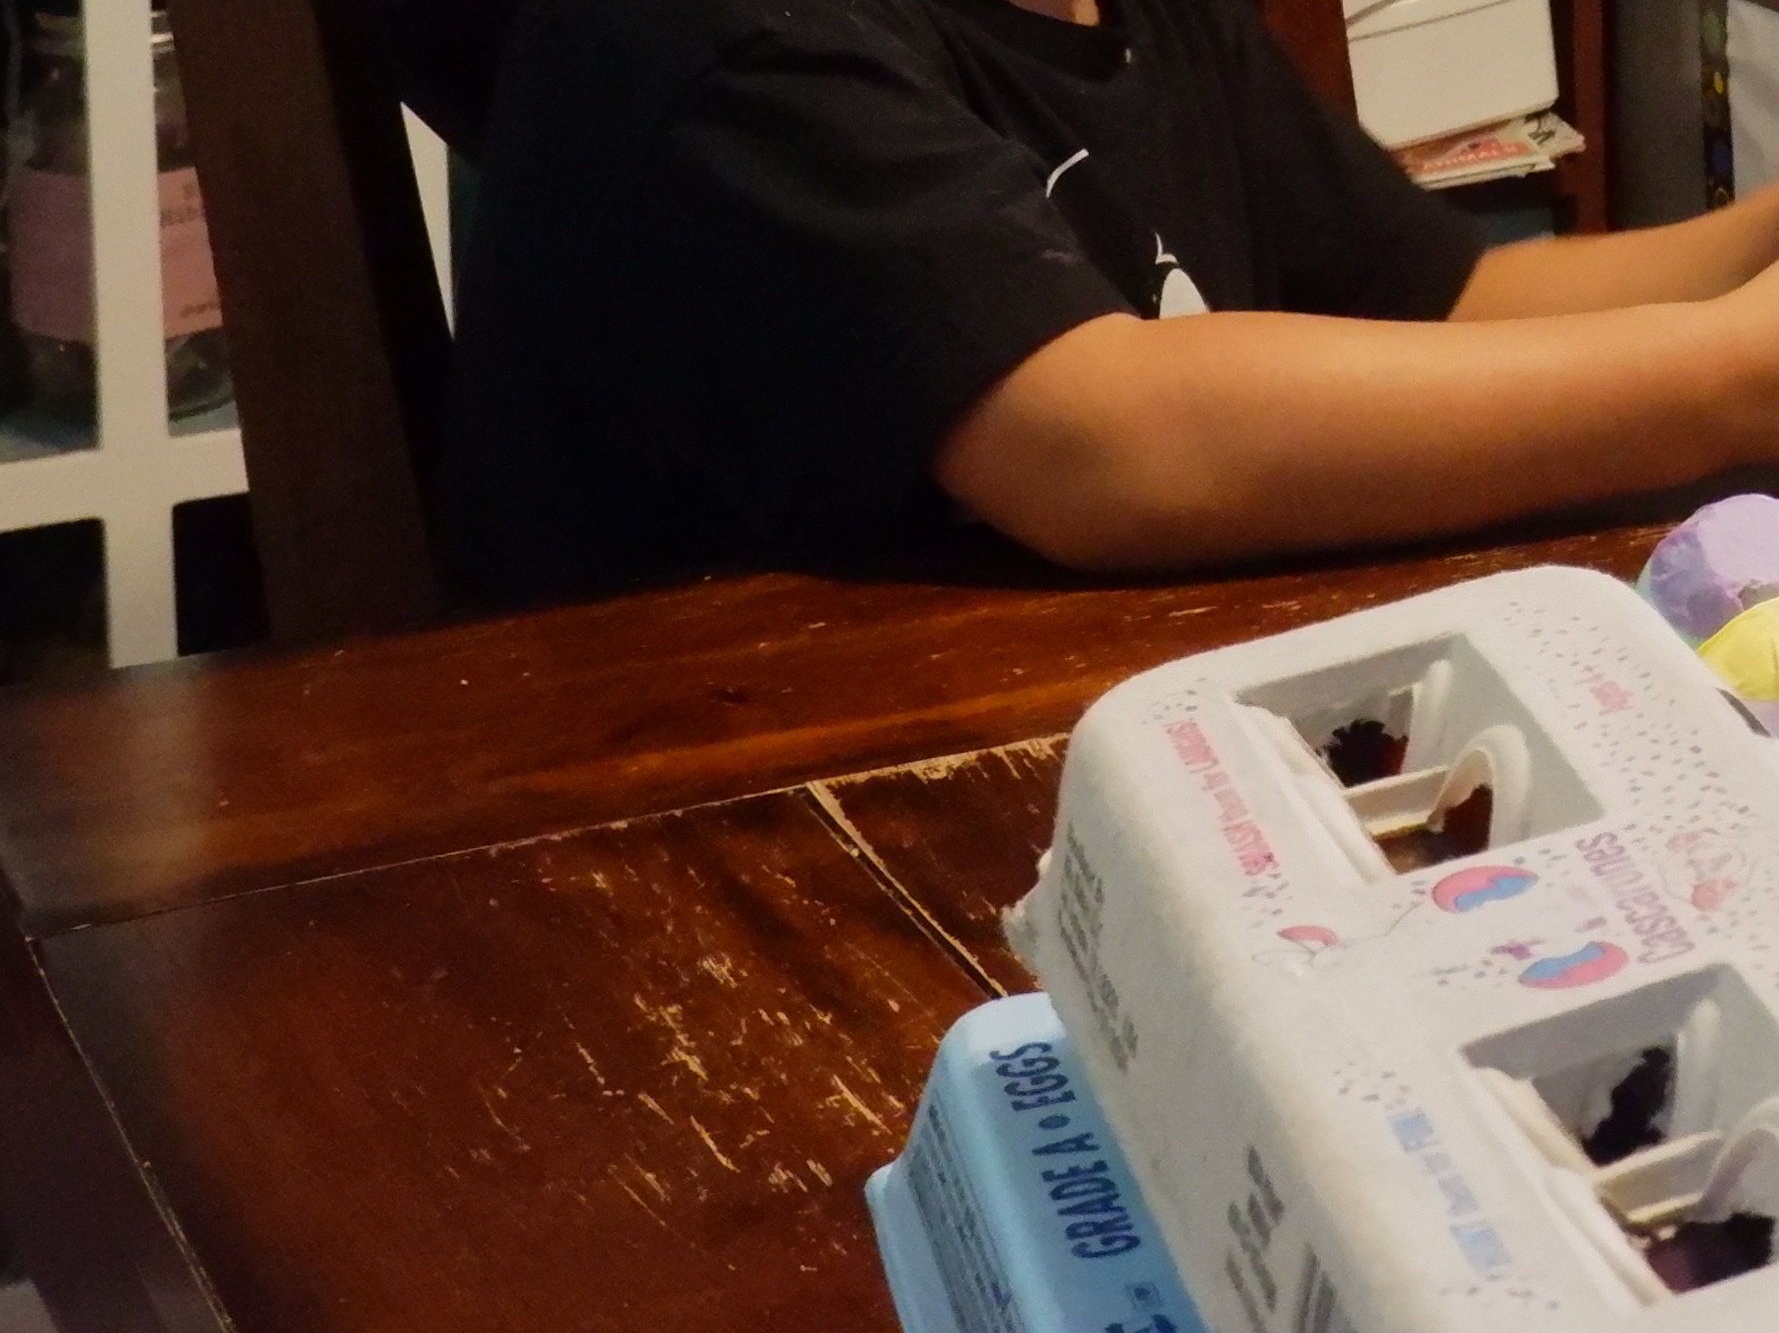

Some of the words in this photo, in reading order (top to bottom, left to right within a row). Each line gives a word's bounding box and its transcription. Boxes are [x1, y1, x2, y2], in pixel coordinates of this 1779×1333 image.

[988, 1041, 1076, 1112] EGGS
[1031, 1131, 1101, 1156] A
[1042, 1159, 1141, 1259] GRADE
